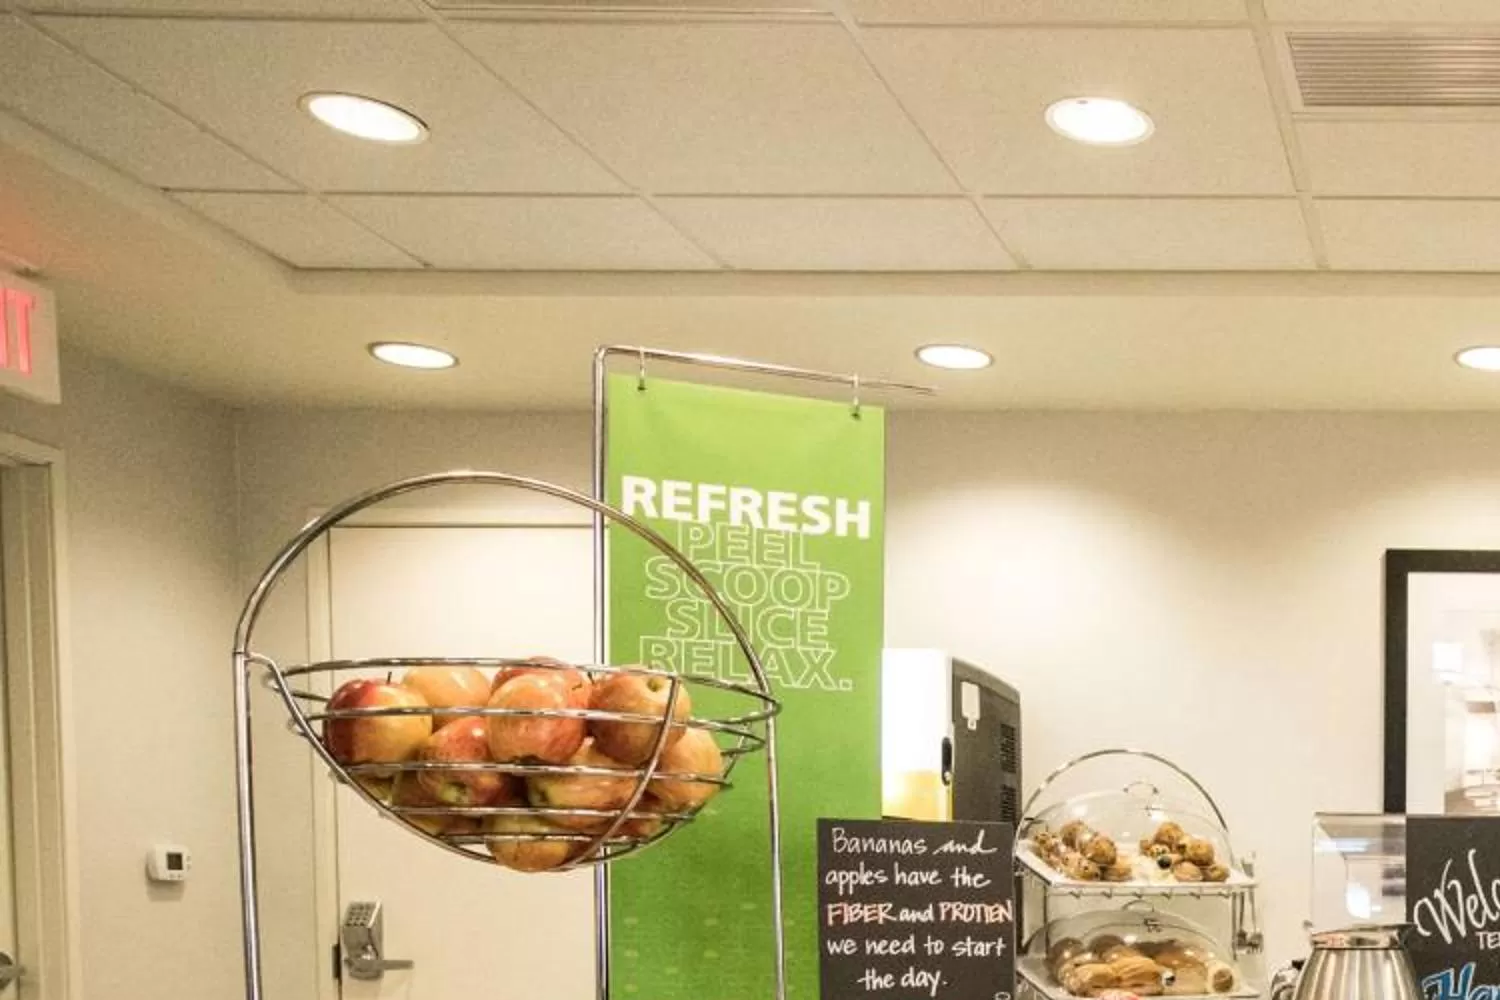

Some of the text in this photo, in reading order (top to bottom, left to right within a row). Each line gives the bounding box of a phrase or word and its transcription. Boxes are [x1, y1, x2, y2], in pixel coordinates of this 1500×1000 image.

[621, 475, 871, 540] REFRESH
[678, 521, 820, 570] PEEL
[644, 556, 850, 611] SCOOP
[665, 598, 831, 650] SLICE
[639, 636, 853, 691] RELAX.
[831, 827, 998, 855] Bananas and
[825, 861, 992, 896] apples have the
[827, 902, 897, 927] FIBER
[899, 904, 934, 922] and
[827, 934, 1007, 957] we need to start
[857, 966, 949, 997] the day.
